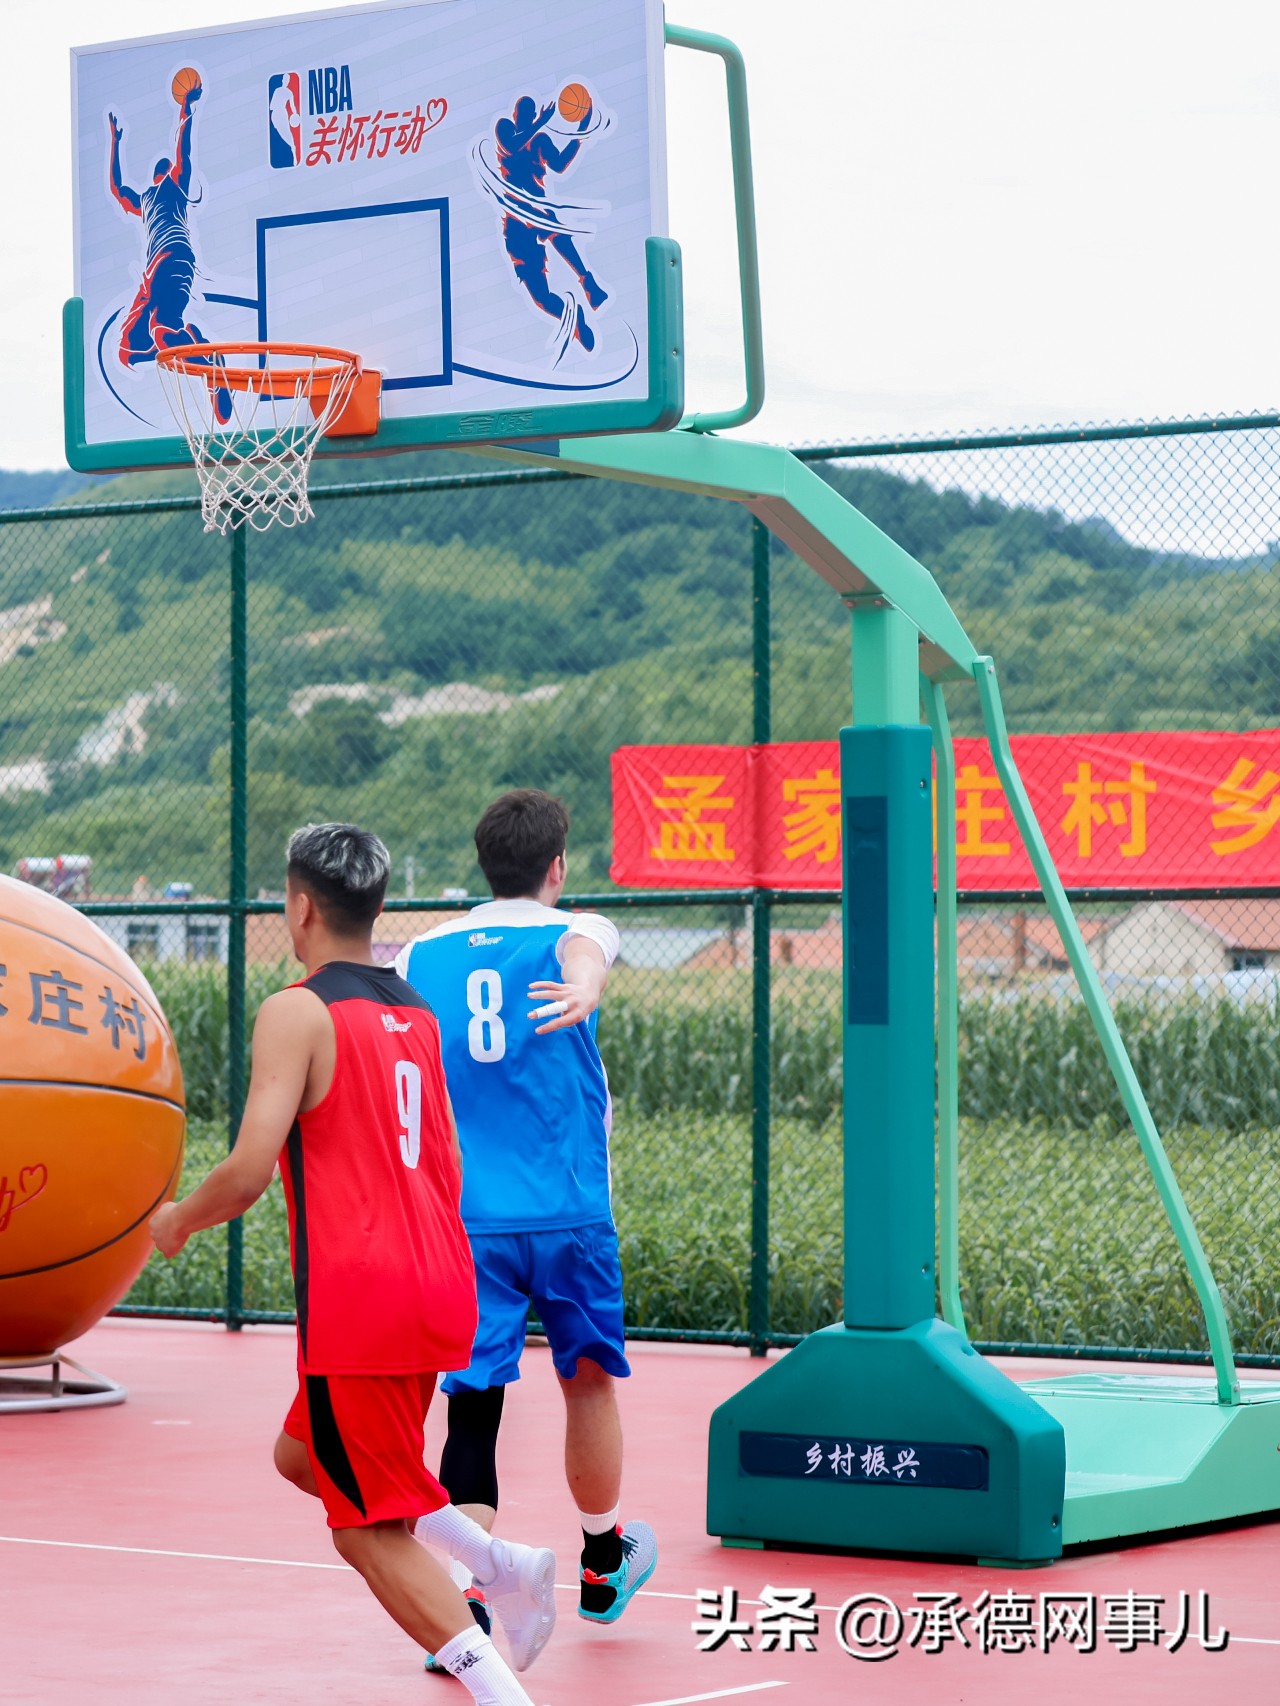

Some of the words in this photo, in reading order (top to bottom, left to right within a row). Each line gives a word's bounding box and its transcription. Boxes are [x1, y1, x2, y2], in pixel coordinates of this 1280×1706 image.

[308, 65, 353, 116] NBA
[305, 105, 426, 167] 关怀行动
[467, 969, 506, 1063] 8
[394, 1060, 421, 1169] 9
[804, 1441, 920, 1479] 乡村振兴
